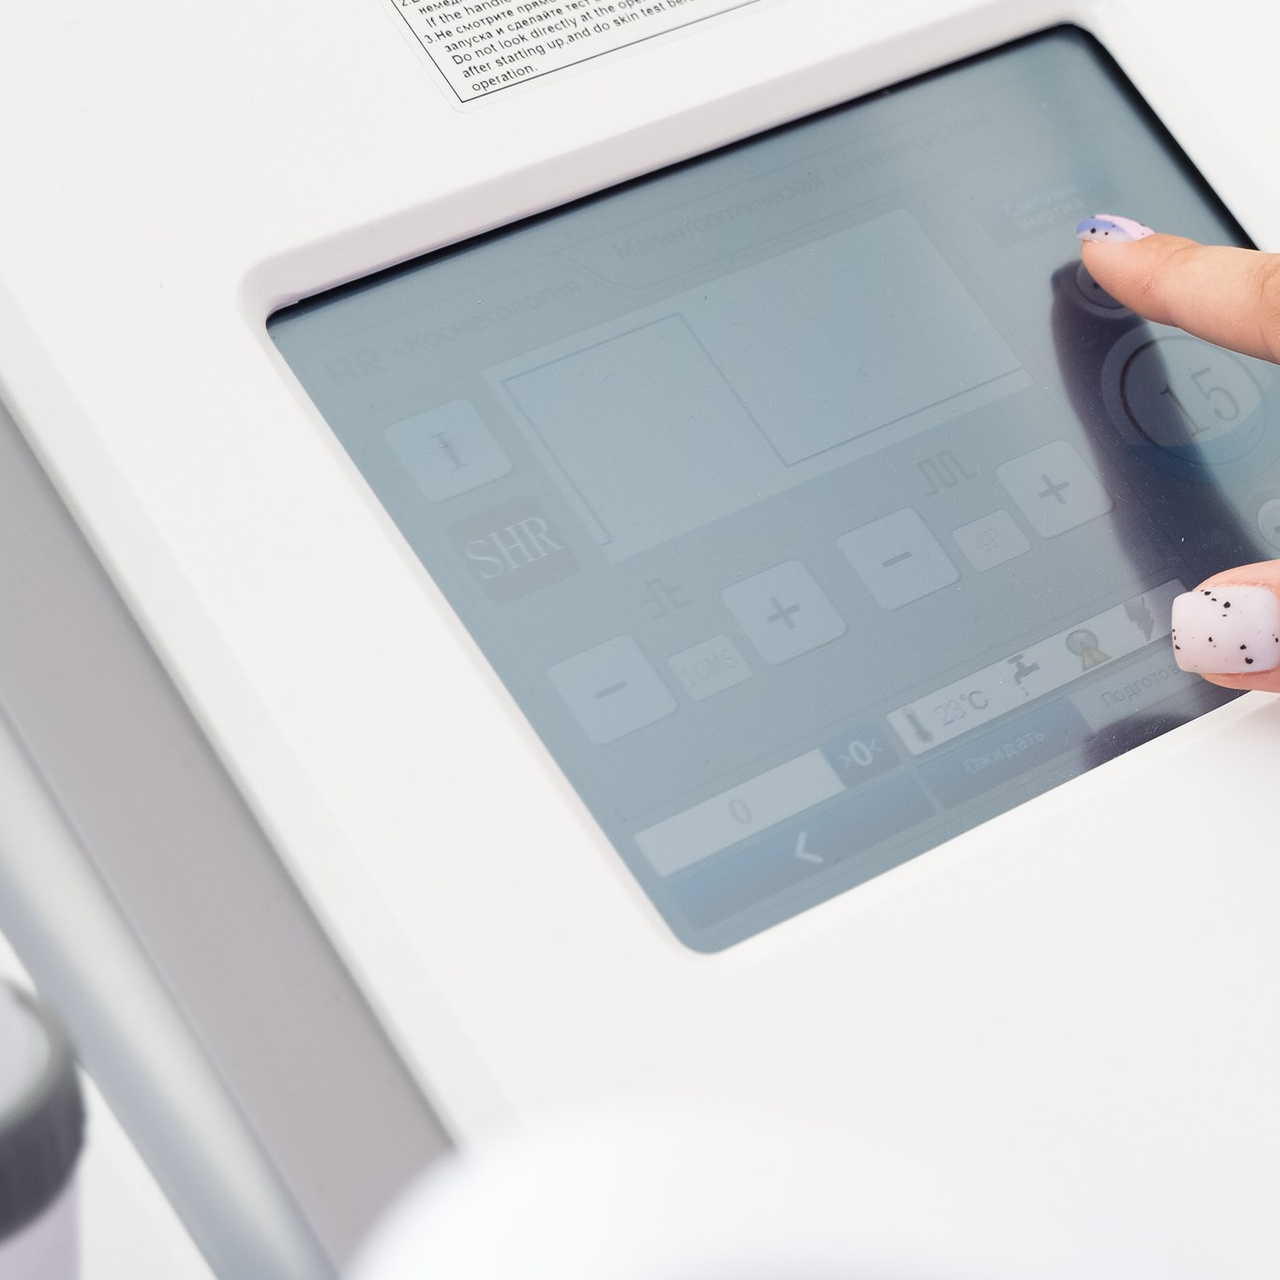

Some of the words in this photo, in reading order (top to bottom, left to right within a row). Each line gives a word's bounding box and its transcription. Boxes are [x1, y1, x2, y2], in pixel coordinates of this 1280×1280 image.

[425, 16, 437, 28] If
[438, 11, 462, 24] the
[444, 31, 493, 52] запуска
[507, 8, 563, 31] сделайте
[451, 53, 472, 65] Do
[474, 43, 498, 58] not
[497, 33, 529, 49] look
[530, 17, 577, 39] directly
[580, 11, 593, 22] at
[593, 5, 616, 17] the
[455, 9, 514, 33] смотрите
[462, 62, 491, 78] after
[495, 44, 546, 67] starting
[593, 22, 610, 33] do
[612, 12, 640, 27] skin
[639, 2, 666, 17] test
[471, 65, 537, 91] operation.
[1161, 366, 1240, 437] 15
[464, 515, 564, 580] SHR
[1100, 665, 1181, 708] Подготов
[964, 731, 1045, 774] Ожидать
[727, 798, 753, 826] 0
